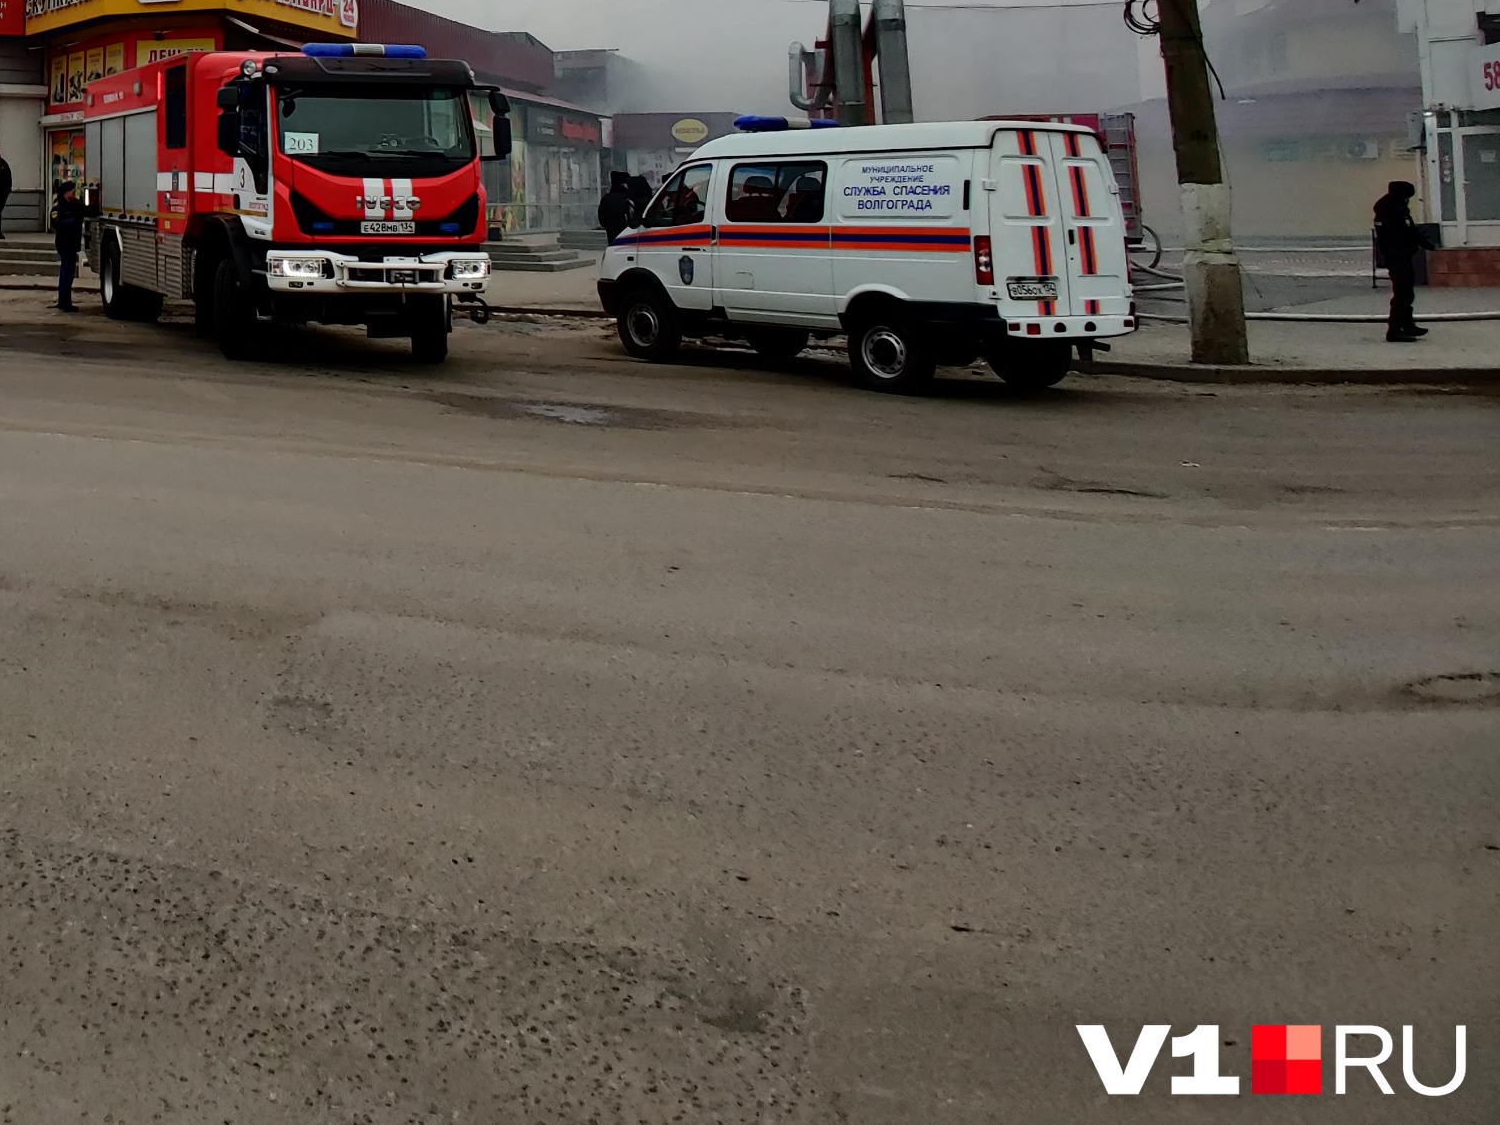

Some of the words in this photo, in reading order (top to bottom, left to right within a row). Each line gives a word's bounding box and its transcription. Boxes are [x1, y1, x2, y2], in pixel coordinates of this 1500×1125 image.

[289, 138, 313, 150] 203
[862, 165, 934, 173] МУНИЦИПАЛЬНОЕ
[240, 167, 246, 188] 3
[870, 175, 924, 183] УЧРЕЖДЕНИЕ
[843, 186, 886, 196] СЛУЖБА
[893, 185, 950, 195] СПАСЕНИЯ
[356, 196, 421, 210] IVECO
[858, 200, 932, 211] ВОЛГОГРАДА
